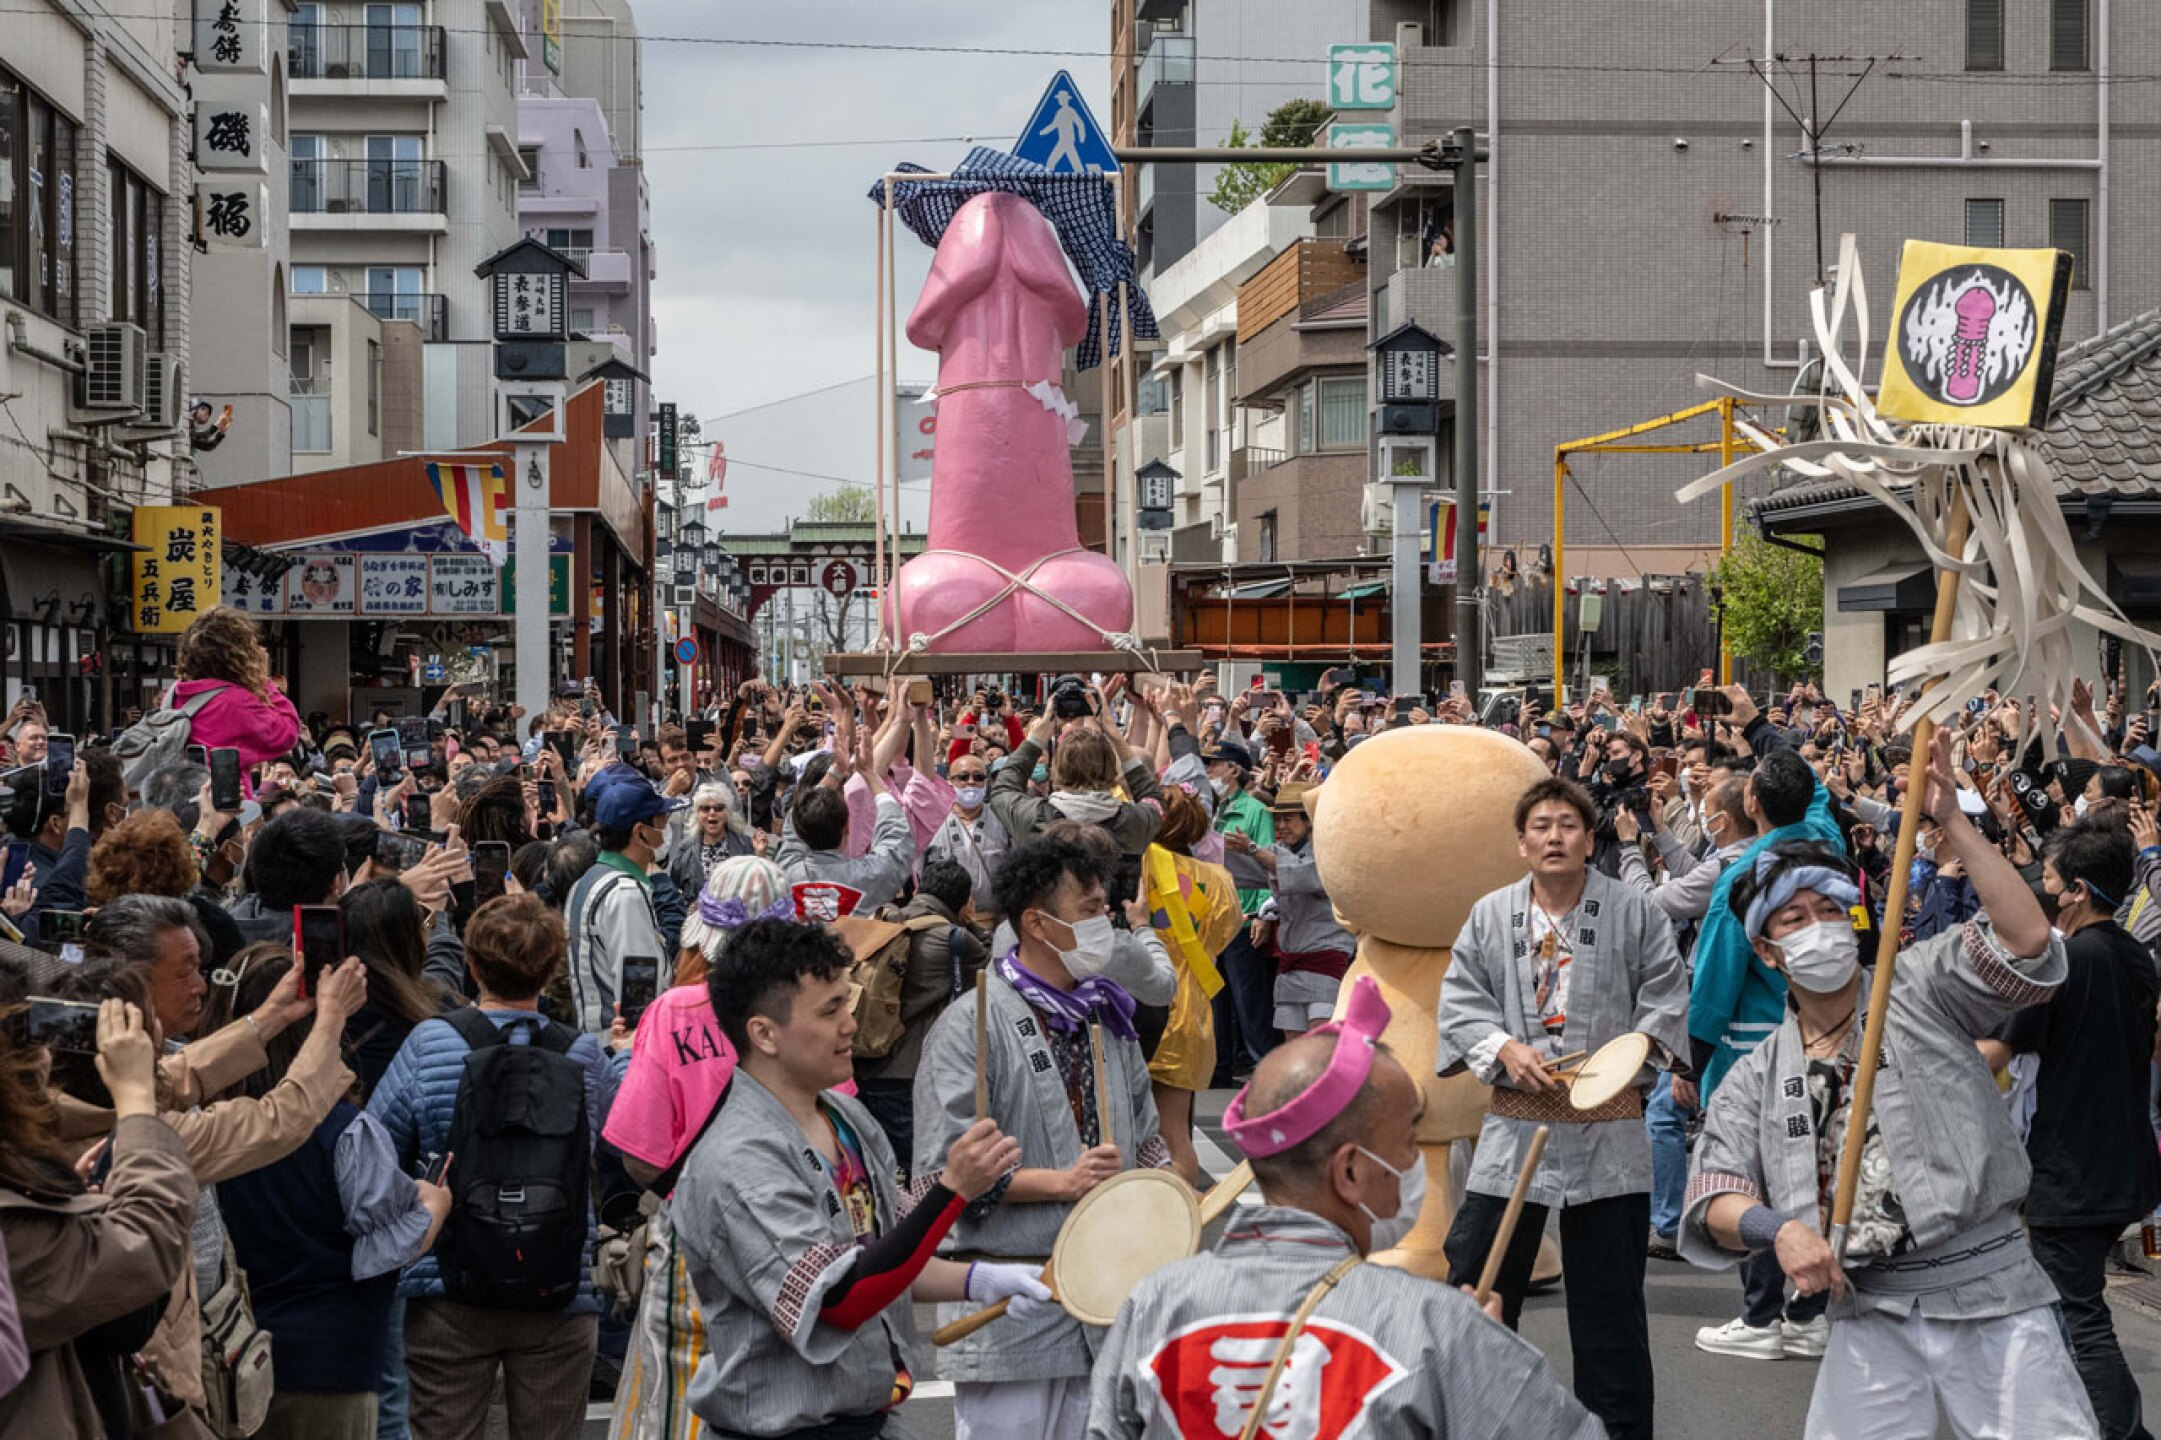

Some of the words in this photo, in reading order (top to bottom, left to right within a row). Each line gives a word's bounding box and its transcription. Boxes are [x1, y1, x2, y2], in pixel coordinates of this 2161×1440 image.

[209, 0, 242, 64] 寿餅
[165, 527, 197, 612] 炭屋
[672, 1024, 726, 1066] KA
